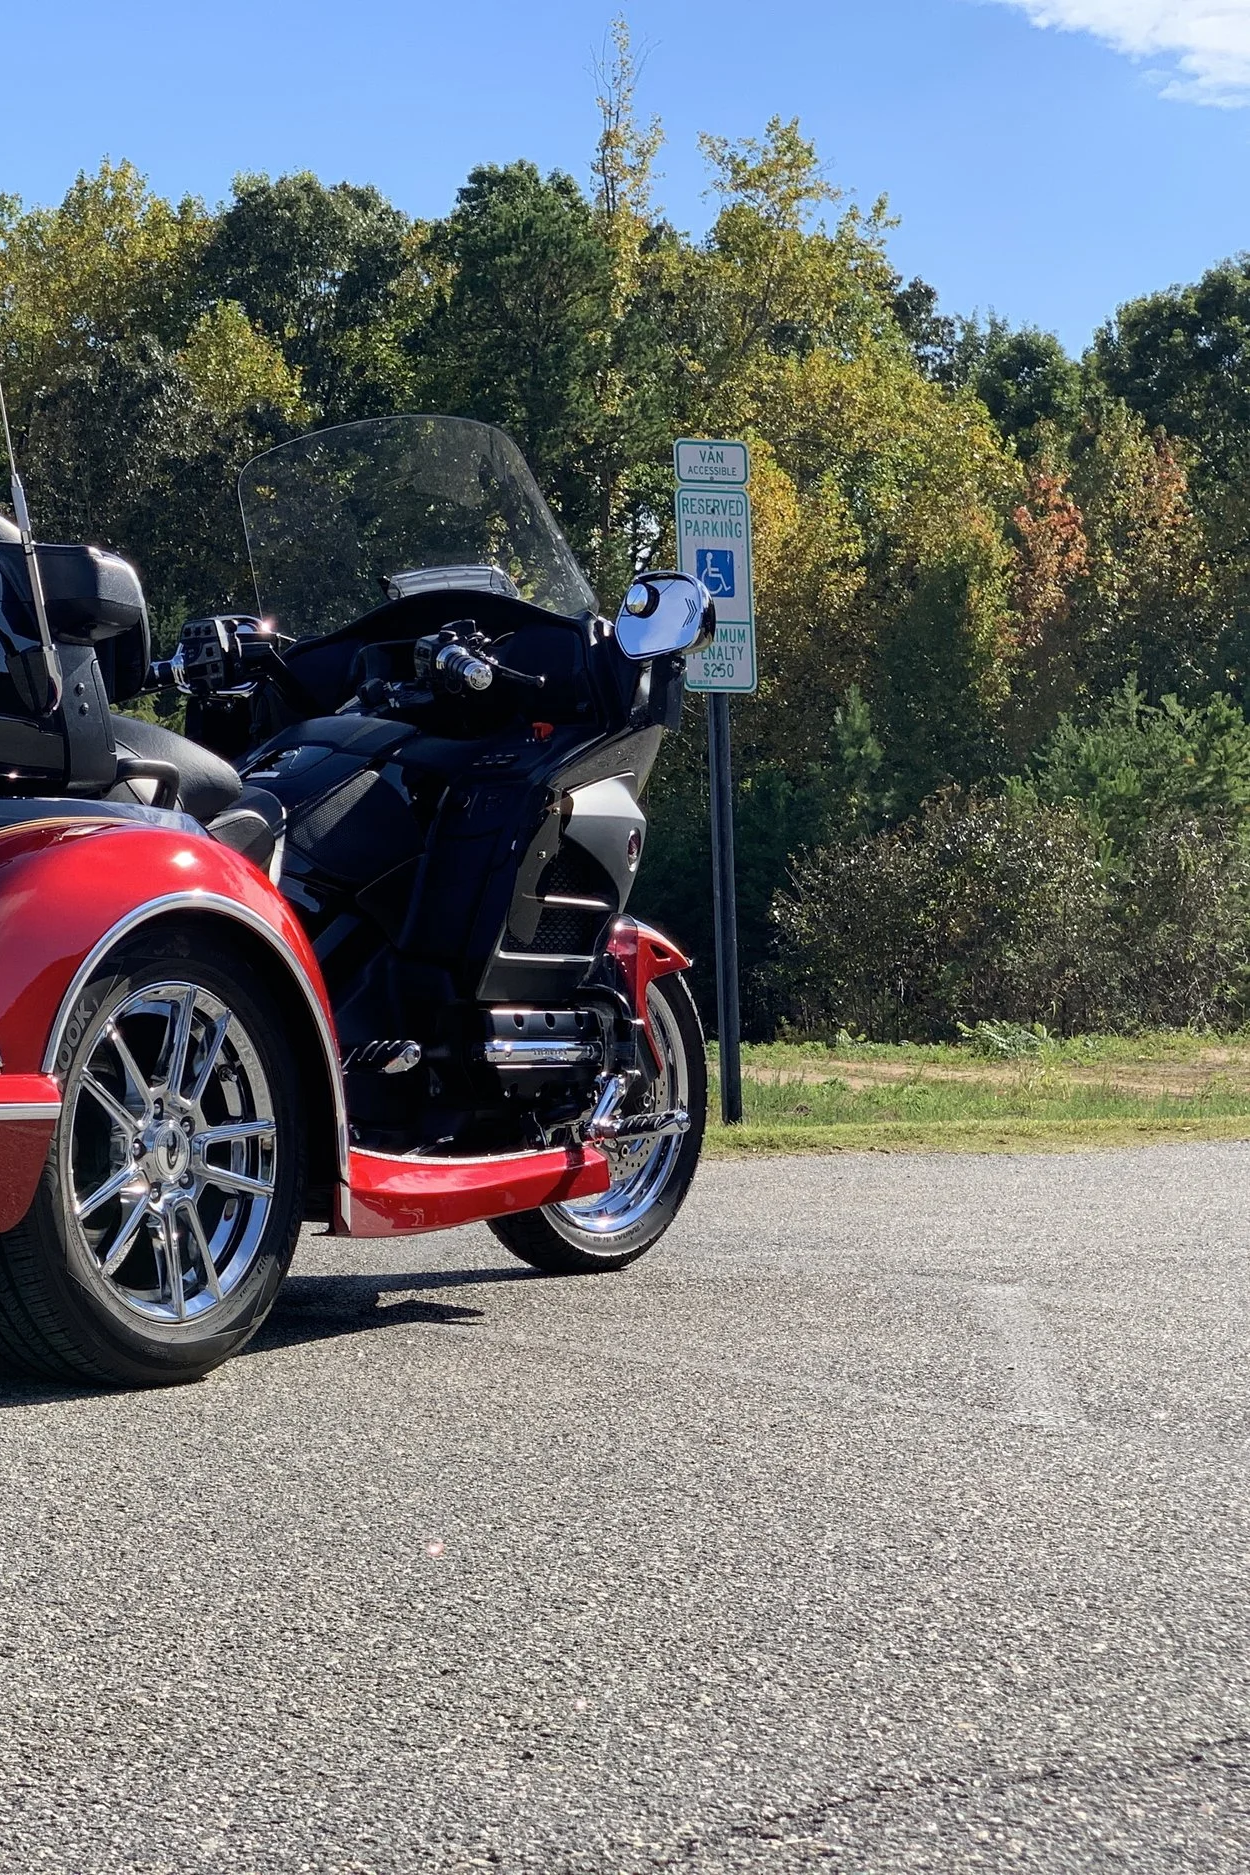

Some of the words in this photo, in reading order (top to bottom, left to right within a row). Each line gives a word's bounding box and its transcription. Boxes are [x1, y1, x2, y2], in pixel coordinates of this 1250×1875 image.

[699, 450, 724, 464] VAN
[687, 465, 737, 477] ACCESSIBLE
[682, 497, 744, 517] RESERVED
[685, 519, 743, 539] PARKING
[716, 628, 746, 643] IMUM
[703, 662, 734, 678] $250
